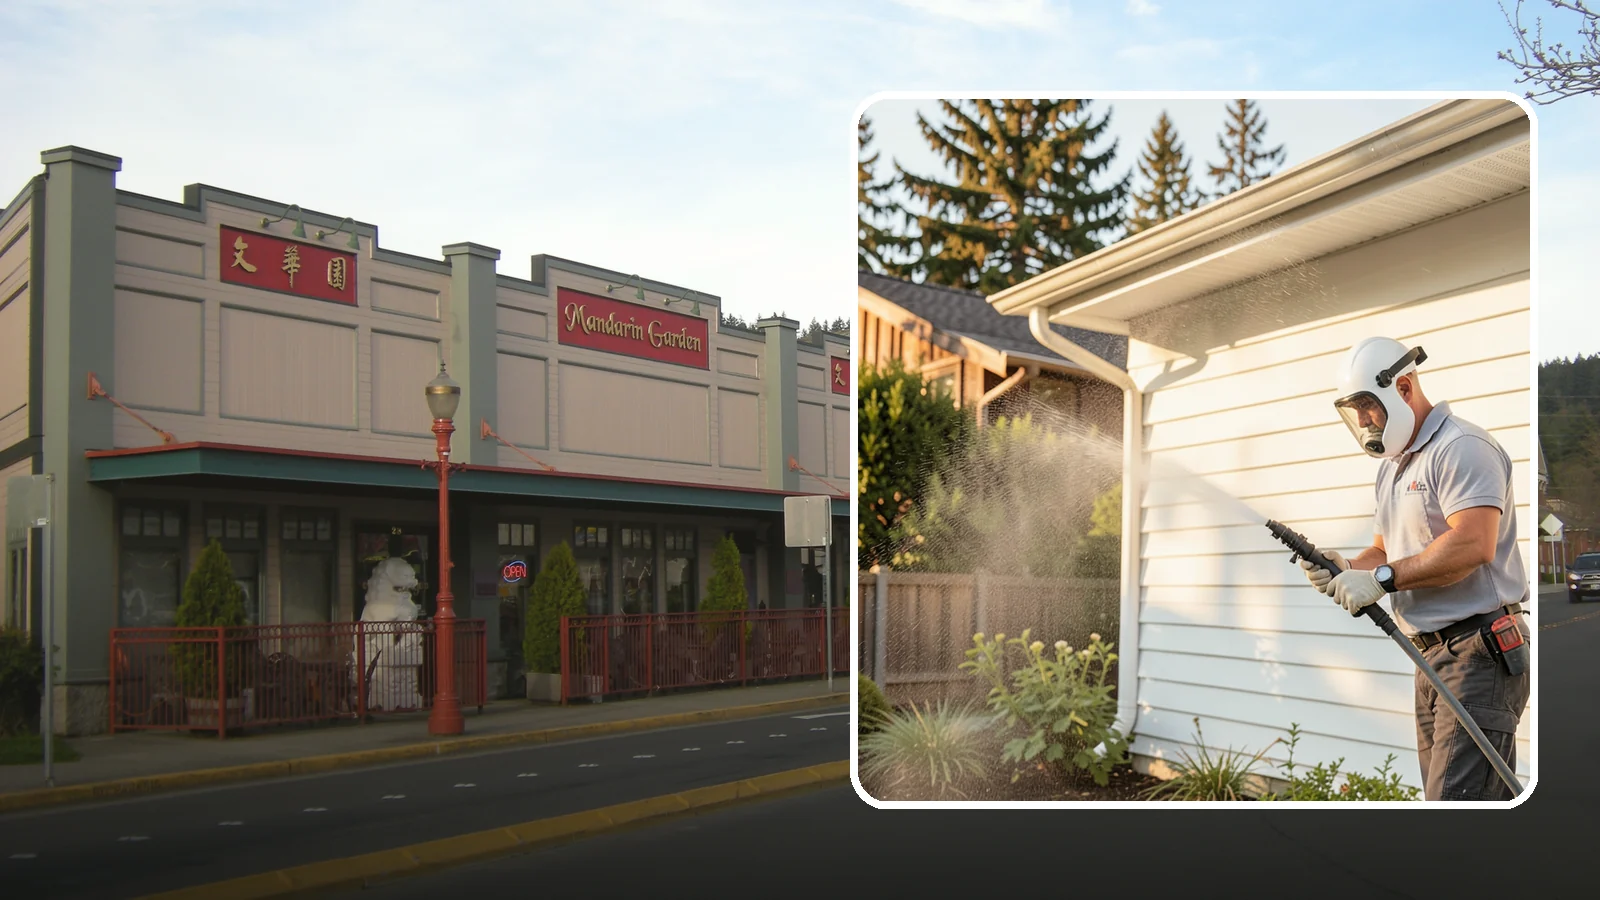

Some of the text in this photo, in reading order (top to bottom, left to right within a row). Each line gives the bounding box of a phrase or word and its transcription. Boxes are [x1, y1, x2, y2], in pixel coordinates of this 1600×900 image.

[231, 235, 346, 291] 文華園
[564, 302, 702, 352] Mandarin Garden
[503, 565, 527, 578] OPEN
